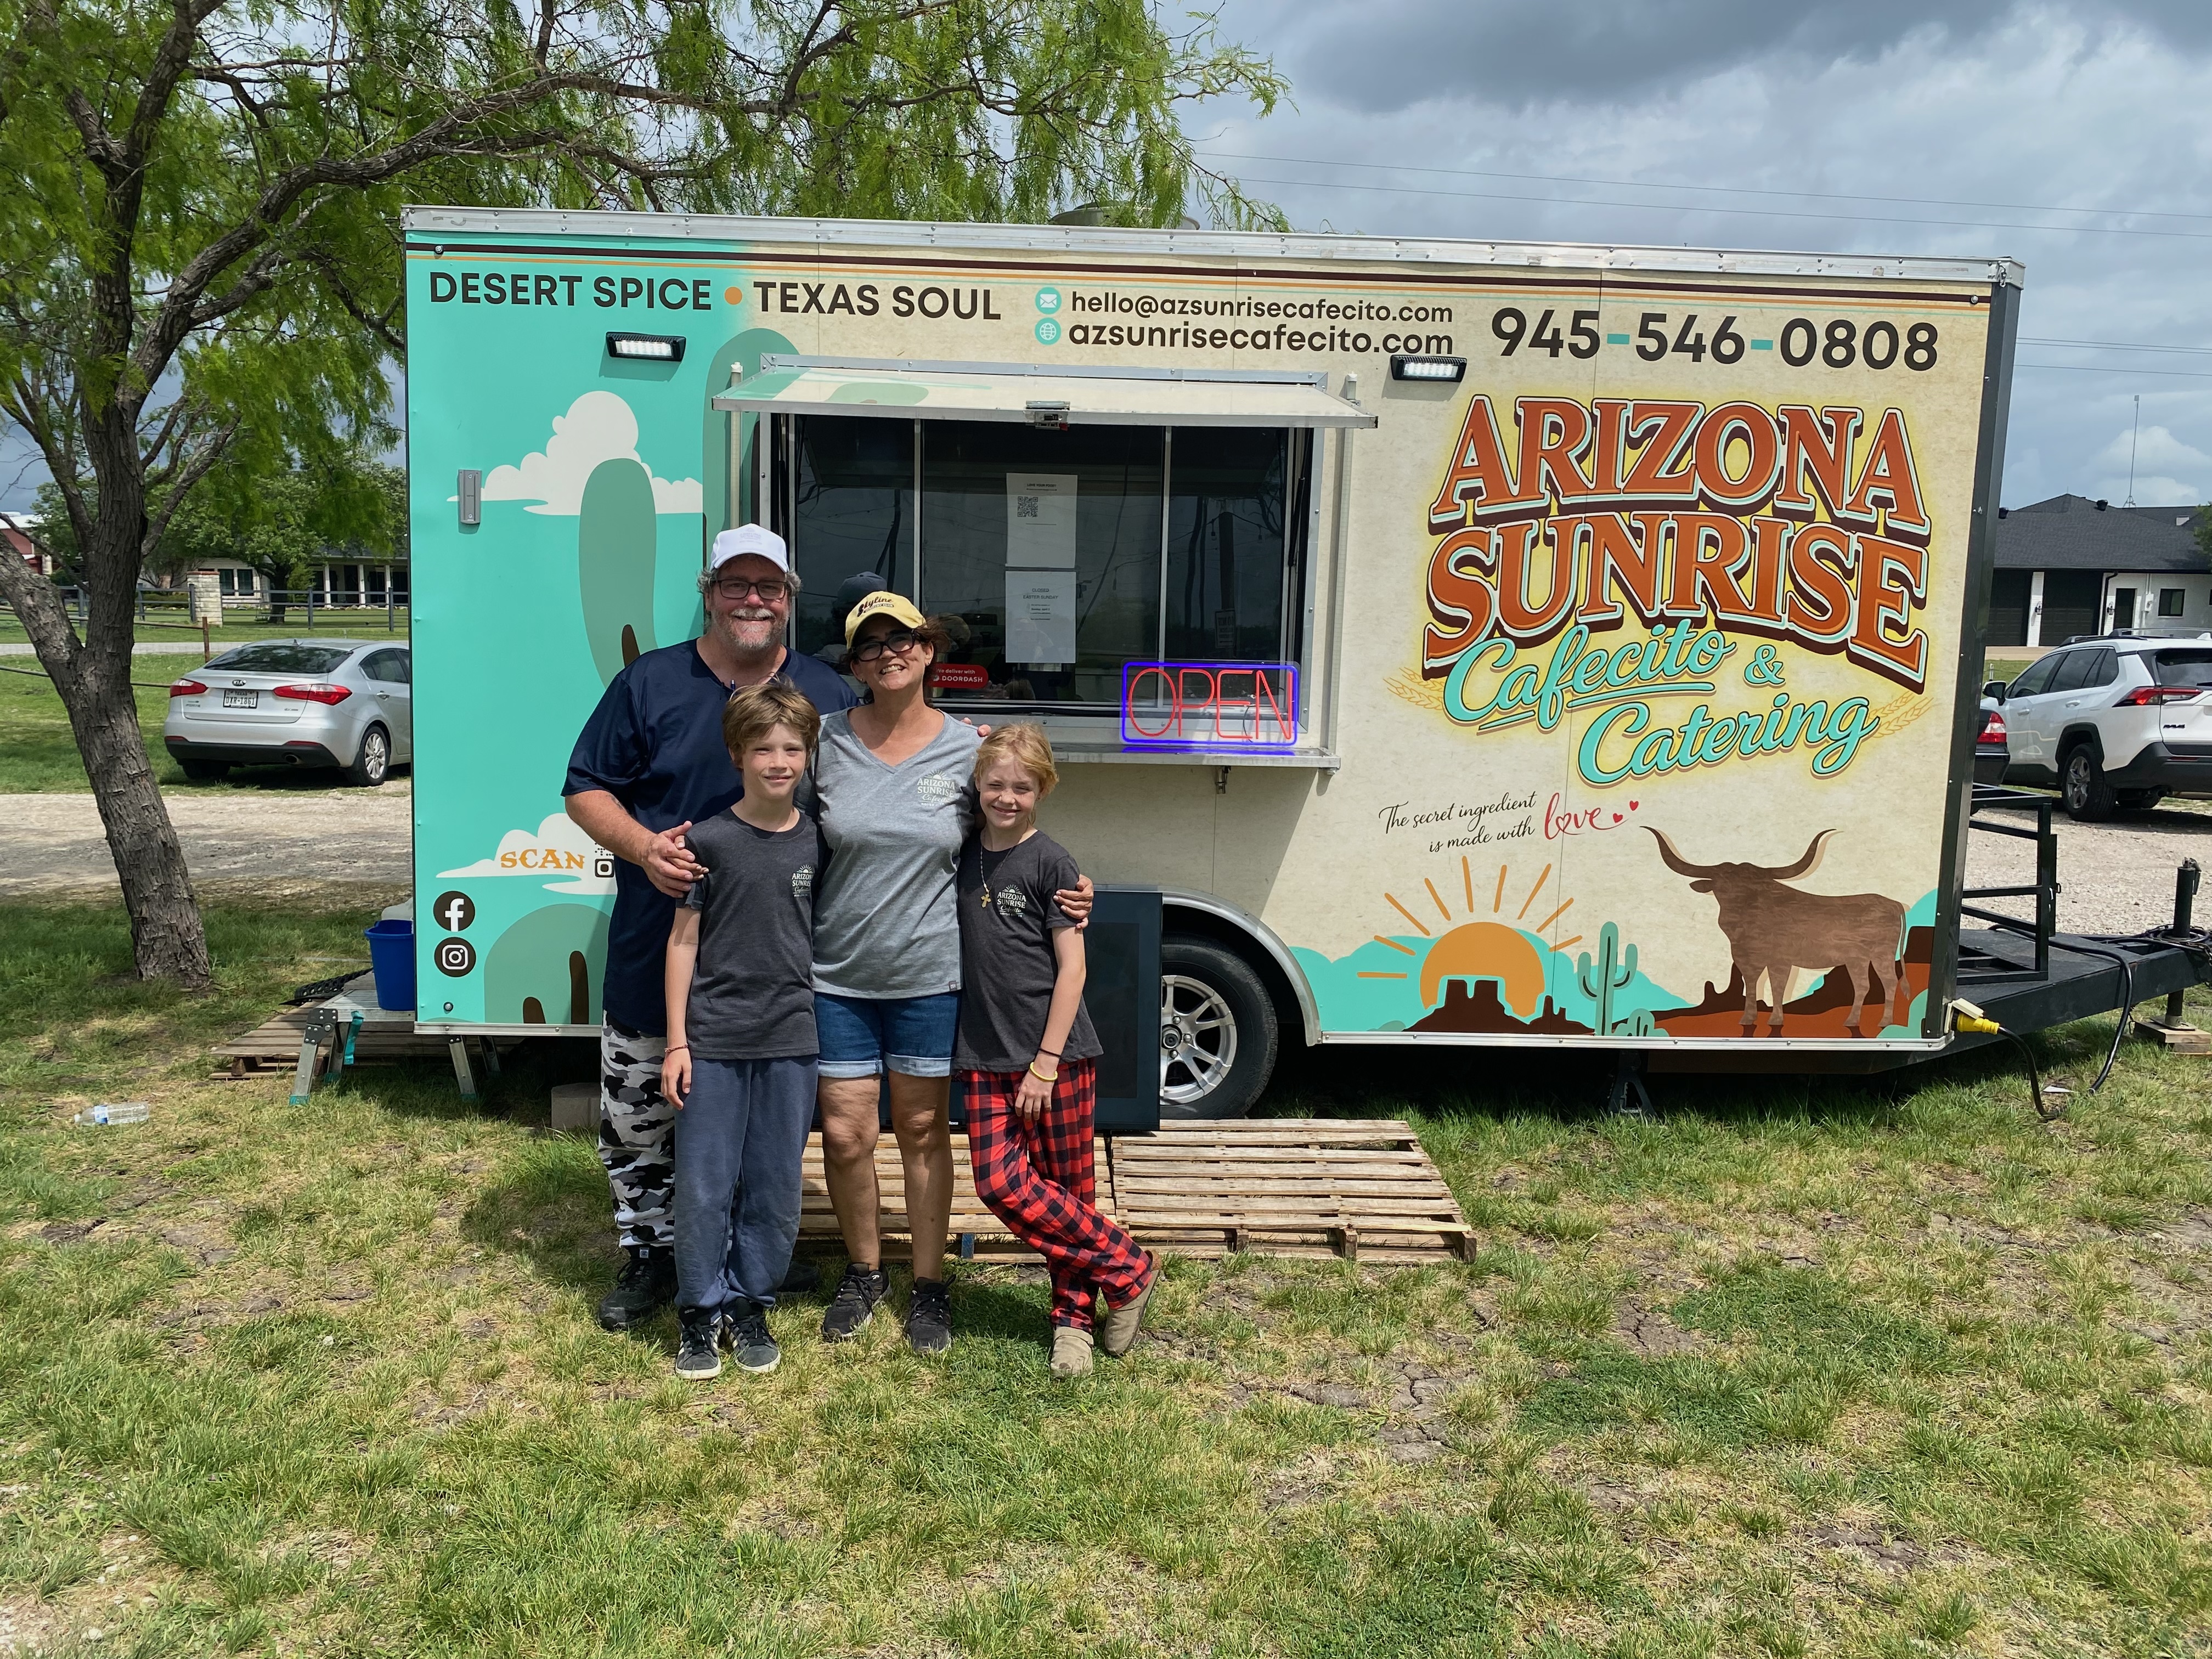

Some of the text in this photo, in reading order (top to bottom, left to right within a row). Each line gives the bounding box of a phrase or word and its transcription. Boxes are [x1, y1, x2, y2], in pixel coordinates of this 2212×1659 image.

[430, 272, 712, 311] DESERT SPICE
[753, 281, 1001, 320] TEXAS SOUL
[1072, 291, 1452, 323] hello@azsunrisecafecito.com
[1069, 321, 1453, 354] azsunrisecafecito.com
[1492, 307, 1938, 371] 945-546-0808
[1428, 393, 1931, 548] ARIZONA
[857, 596, 893, 617] Skyline
[1422, 511, 1929, 695] SUNRISE
[1443, 618, 1786, 732] Cafecito &
[1128, 668, 1293, 740] OPEN
[1577, 692, 1881, 788] Catering
[917, 778, 955, 790] ARIZONA
[917, 786, 955, 798] SUNRISE
[1379, 791, 1537, 834] The secret ingredient
[1429, 792, 1623, 853] is made with love
[500, 849, 585, 870] SCAN
[997, 891, 1026, 902] ARIZONA
[997, 898, 1026, 909] SUNRISE
